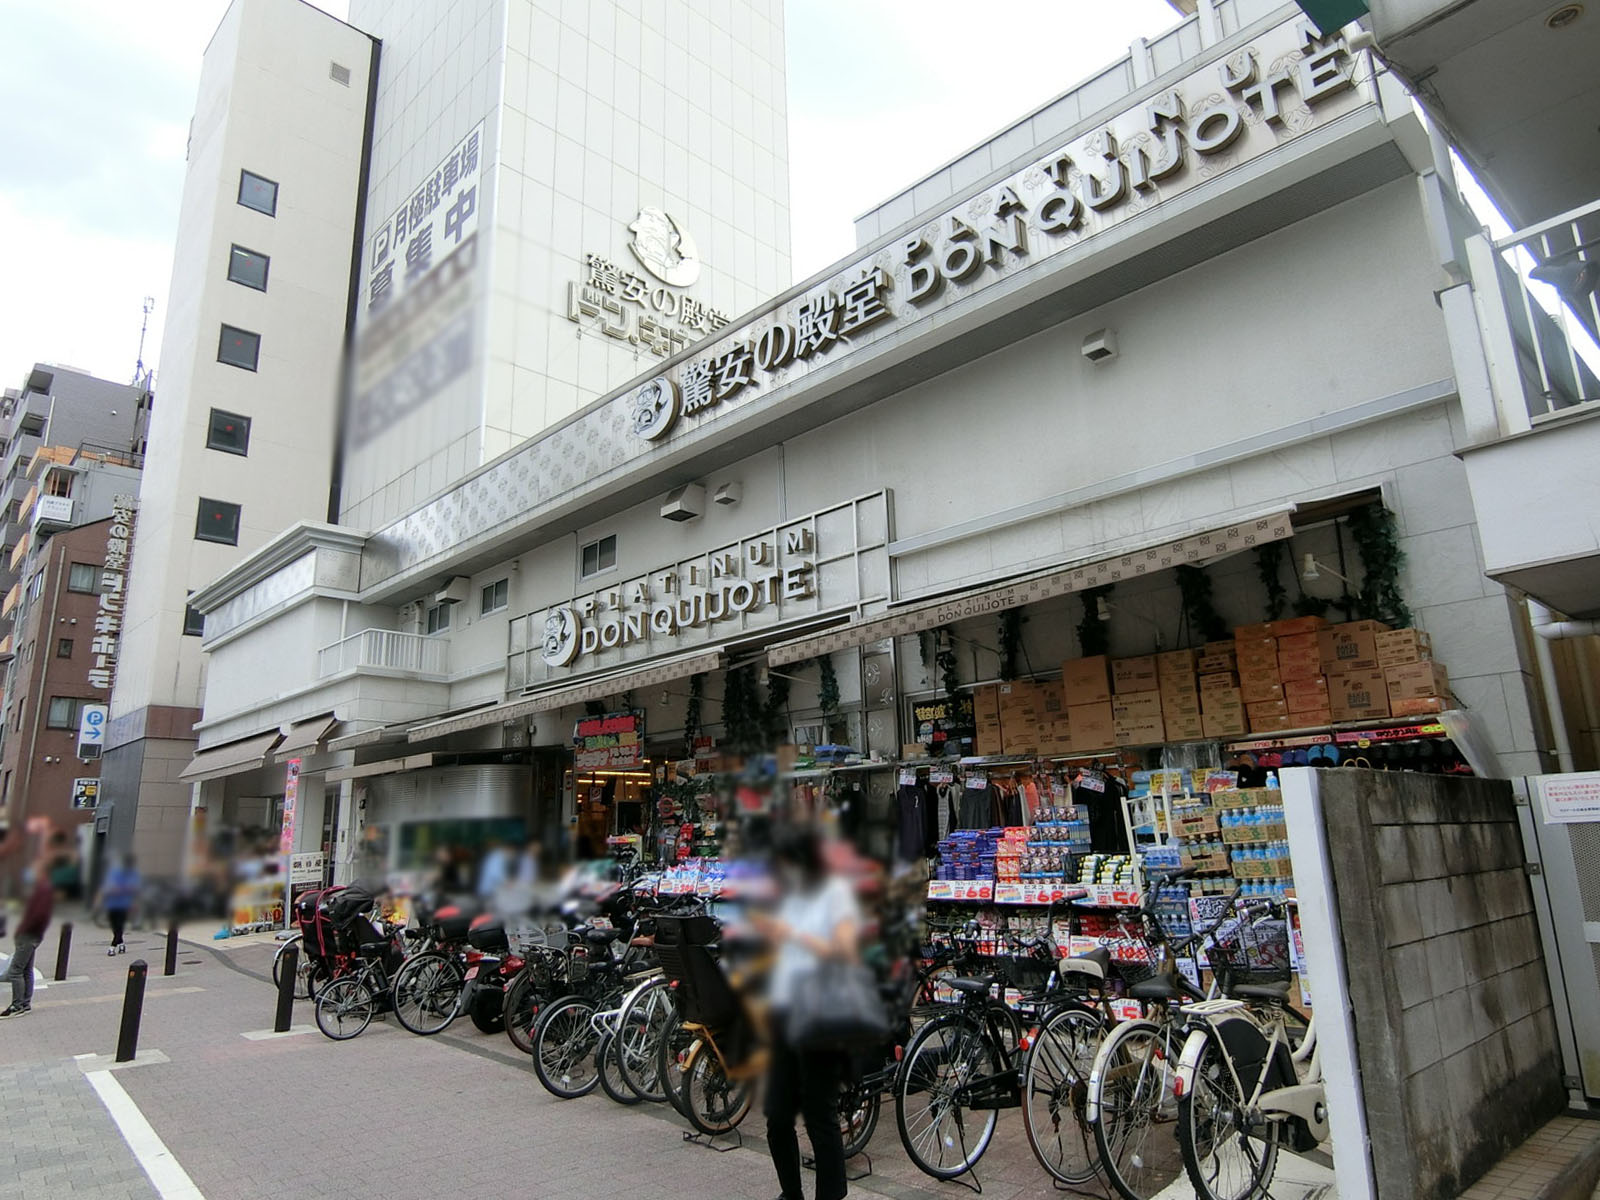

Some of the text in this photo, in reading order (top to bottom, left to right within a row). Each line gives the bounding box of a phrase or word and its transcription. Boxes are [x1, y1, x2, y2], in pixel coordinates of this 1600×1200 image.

[393, 131, 480, 250] 月極駐車場
[679, 263, 893, 418] 驚安の殿堂
[582, 527, 813, 619] PLATINUM
[937, 588, 1015, 614] PLATINUM
[966, 886, 991, 898] 68
